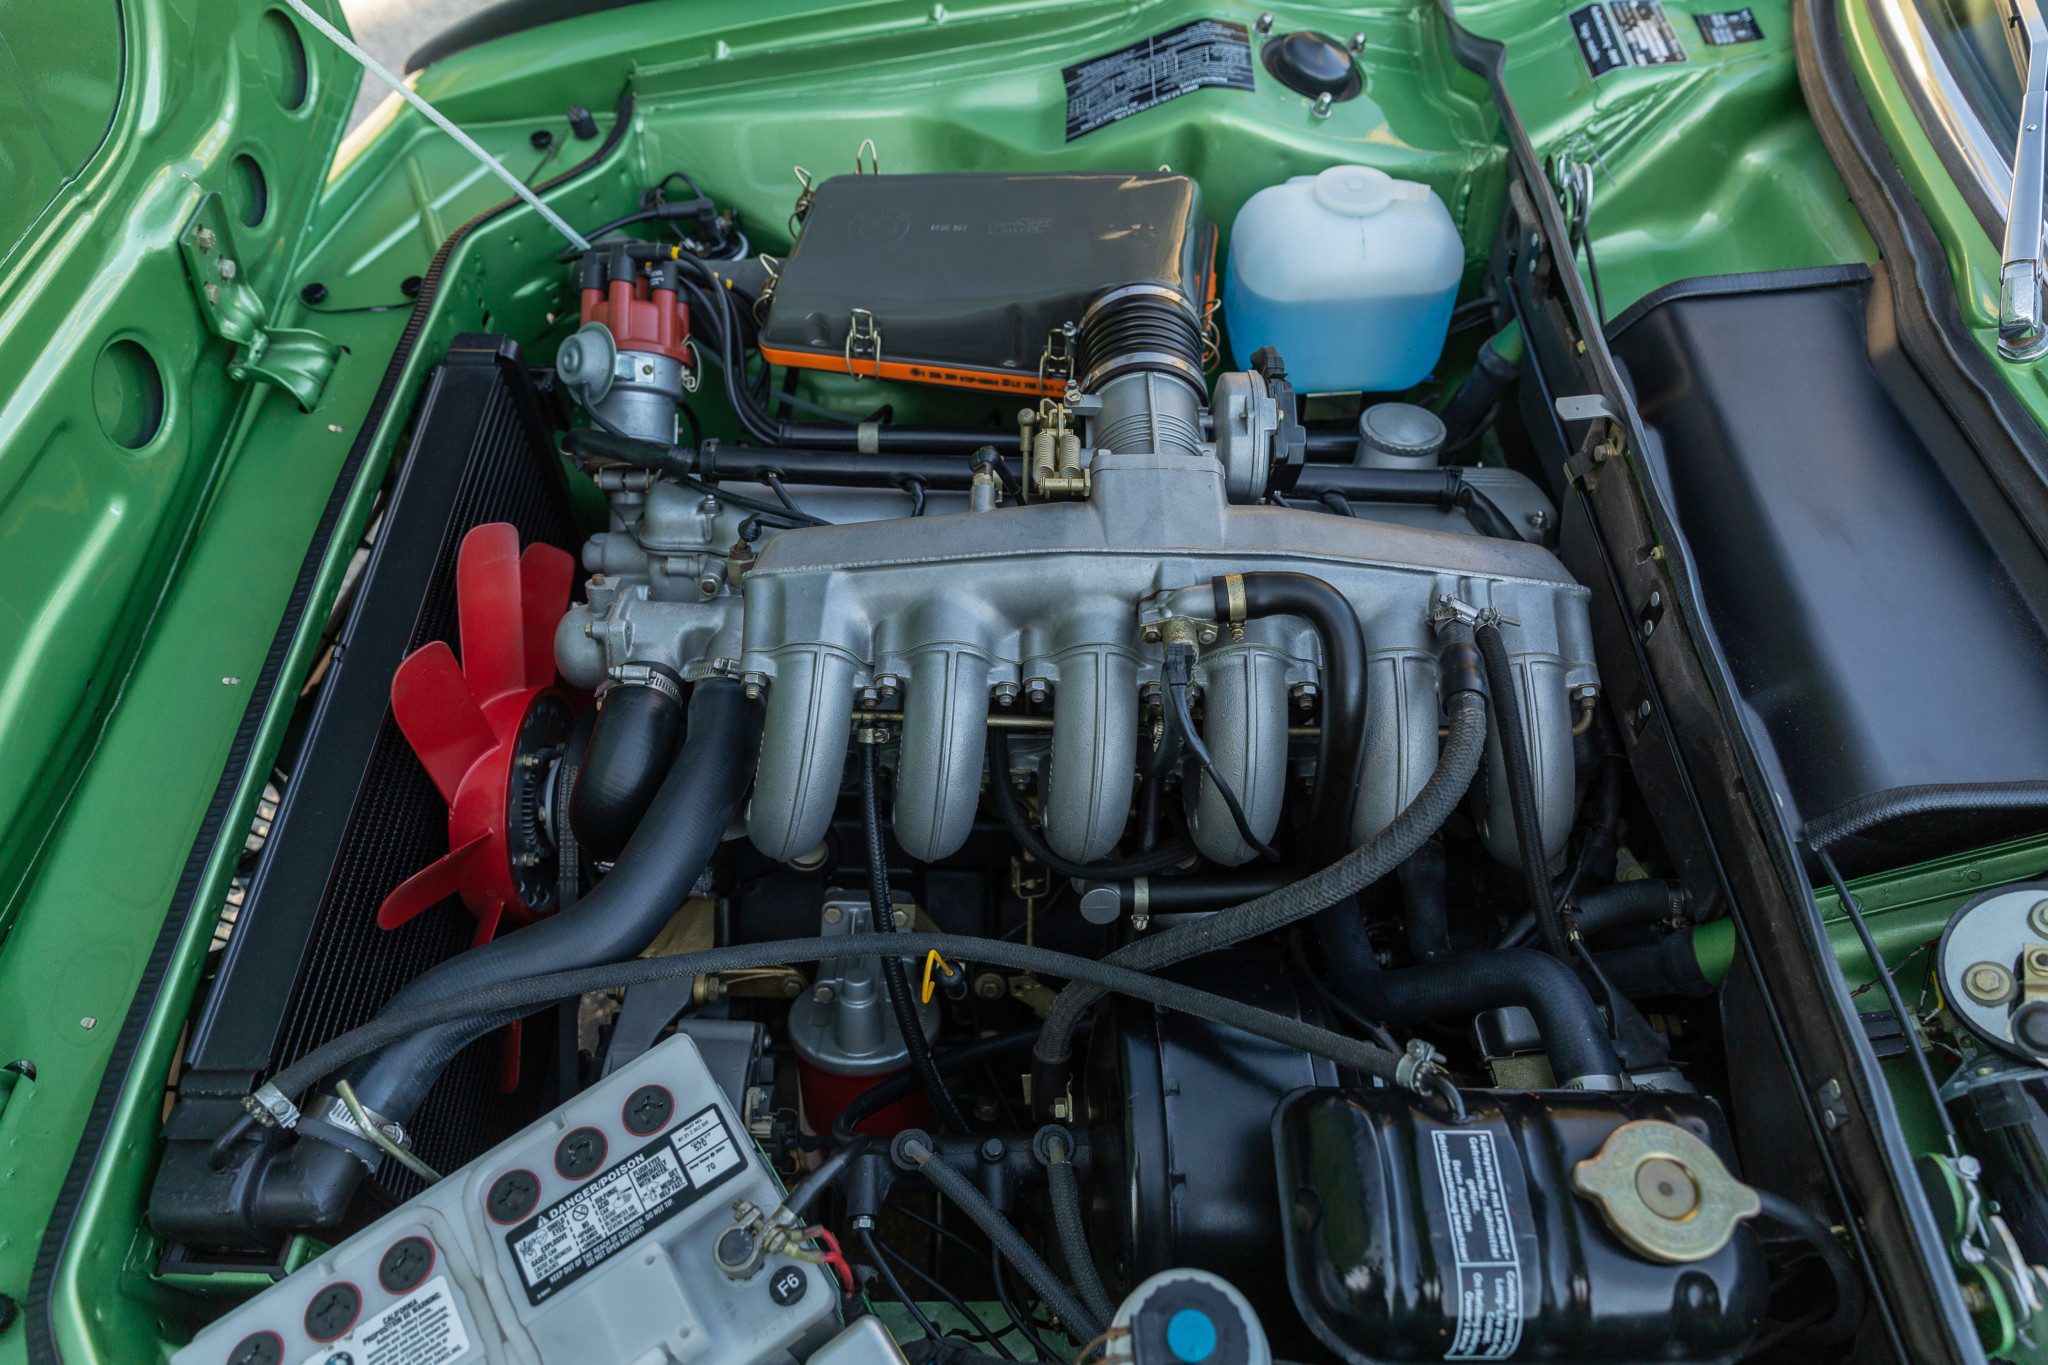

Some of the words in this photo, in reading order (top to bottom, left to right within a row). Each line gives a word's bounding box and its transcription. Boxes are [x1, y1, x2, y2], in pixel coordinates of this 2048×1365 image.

[632, 1163, 648, 1177] FLUSH
[647, 1155, 661, 1167] EYES
[635, 1158, 667, 1182] IMMEDIATELY
[668, 1167, 678, 1177] GET
[705, 1161, 716, 1172] 70
[1438, 1134, 1460, 1213] Betriebsanleitung
[1451, 1159, 1464, 1185] Beim
[1479, 1135, 1497, 1190] Kühlsystem
[1490, 1191, 1500, 1208] mit
[548, 1152, 645, 1220] DANGER/POISON
[638, 1176, 651, 1188] WITH
[659, 1173, 681, 1190] MEDICAL
[594, 1185, 618, 1205] SULFURIC
[658, 1186, 672, 1199] HELP
[596, 1199, 610, 1210] ACID
[599, 1206, 609, 1216] CAN
[546, 1216, 565, 1232] SHIELD
[601, 1209, 616, 1221] CAUSE
[604, 1208, 628, 1227] BLINDNESS
[606, 1218, 623, 1232] SEVERE
[540, 1231, 568, 1253] EXPLOSIVE
[548, 1269, 564, 1283] KEEP
[562, 1262, 575, 1274] OUT
[573, 1256, 583, 1267] OF
[582, 1250, 593, 1261] THE
[592, 1238, 611, 1255] REACH
[609, 1234, 618, 1243] OF
[644, 1211, 654, 1221] DO
[652, 1203, 665, 1215] NOT
[530, 1252, 547, 1267] GASES
[533, 1260, 548, 1274] CAUSE
[547, 1244, 573, 1264] BLINDNESS
[585, 1256, 595, 1267] DO
[593, 1249, 606, 1261] NOT
[605, 1240, 621, 1254] OPEN
[777, 1272, 801, 1298] F6
[1472, 1272, 1483, 1287] On
[1506, 1270, 1518, 1310] Cooling
[362, 1315, 402, 1345] PROPOSITION
[402, 1309, 411, 1319] 65
[411, 1291, 442, 1314] WARNING:
[381, 1299, 417, 1325] CALIFORNIA
[390, 1334, 400, 1344] and
[398, 1338, 408, 1347] and
